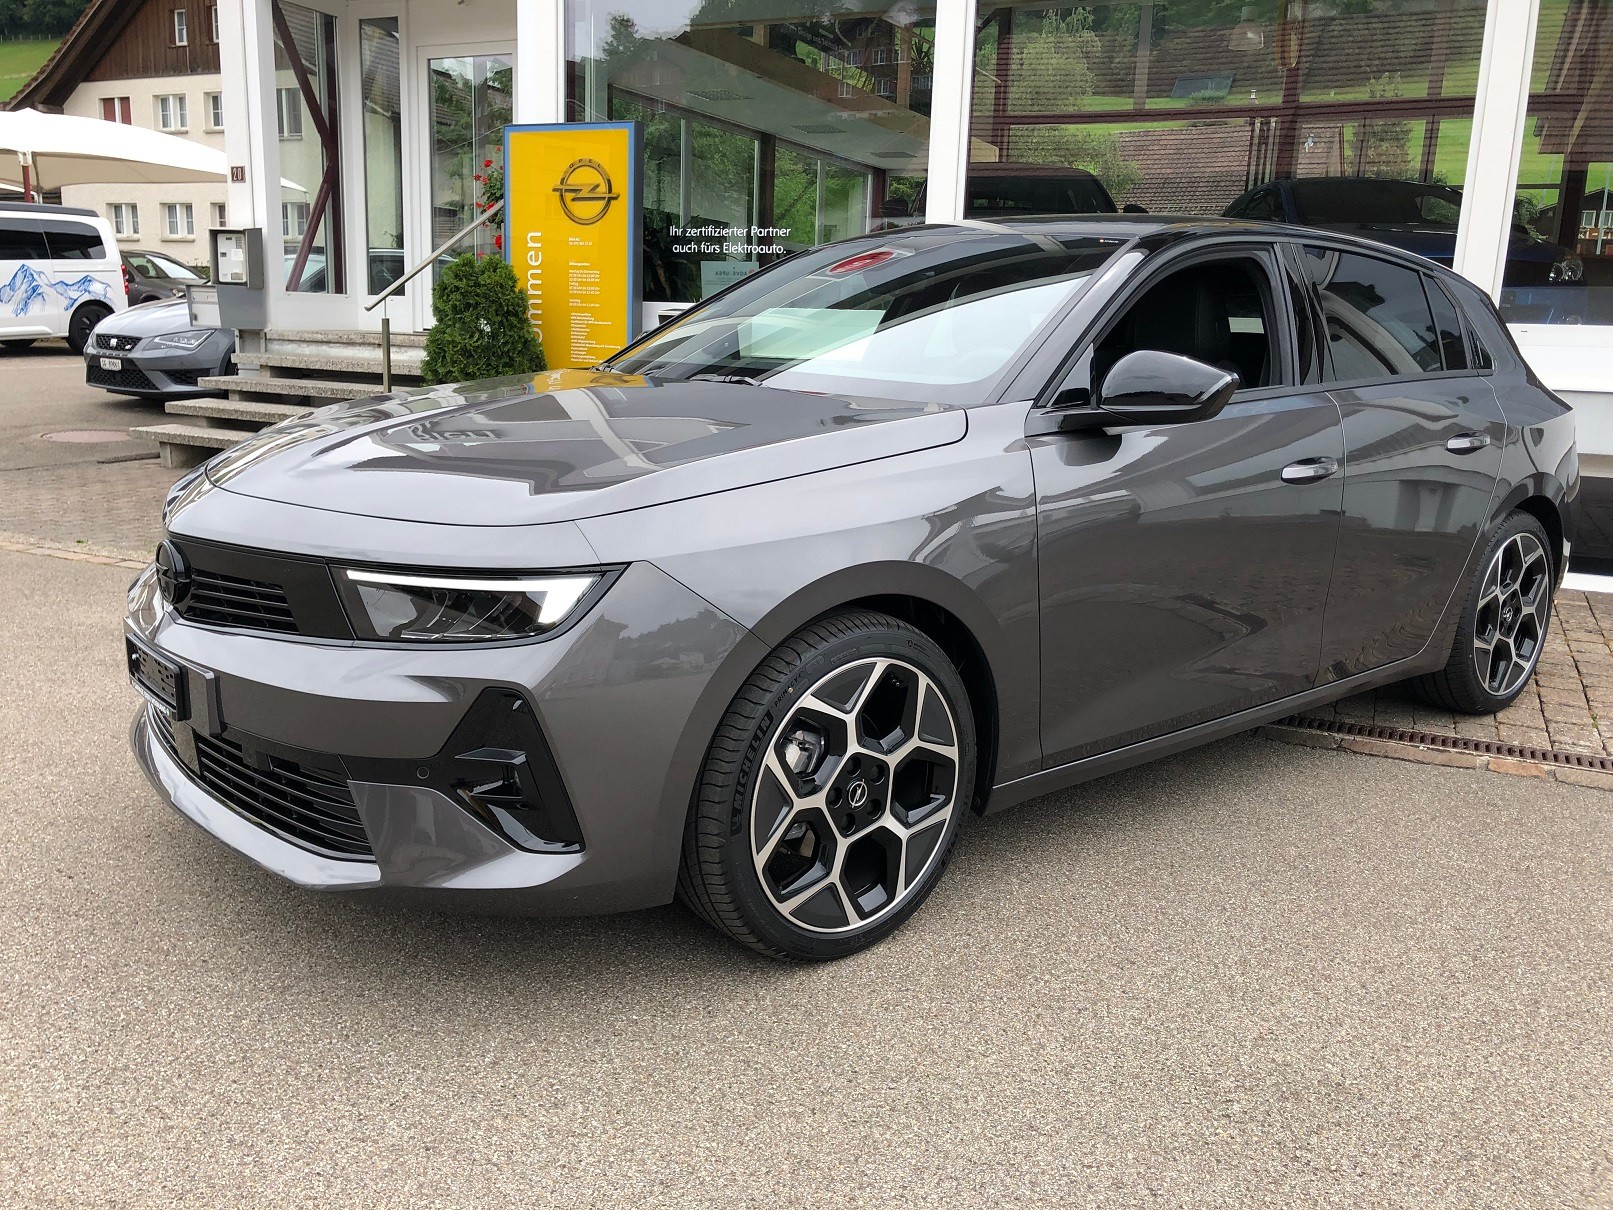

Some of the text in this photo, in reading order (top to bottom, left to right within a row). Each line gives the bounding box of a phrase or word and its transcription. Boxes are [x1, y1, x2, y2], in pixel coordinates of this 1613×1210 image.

[569, 158, 601, 169] OPEL
[232, 168, 242, 180] 20
[669, 225, 791, 237] Ihr zertifizierter Partner
[672, 241, 787, 254] auch fürs Elektroauto.
[733, 712, 772, 812] MICHELIN
